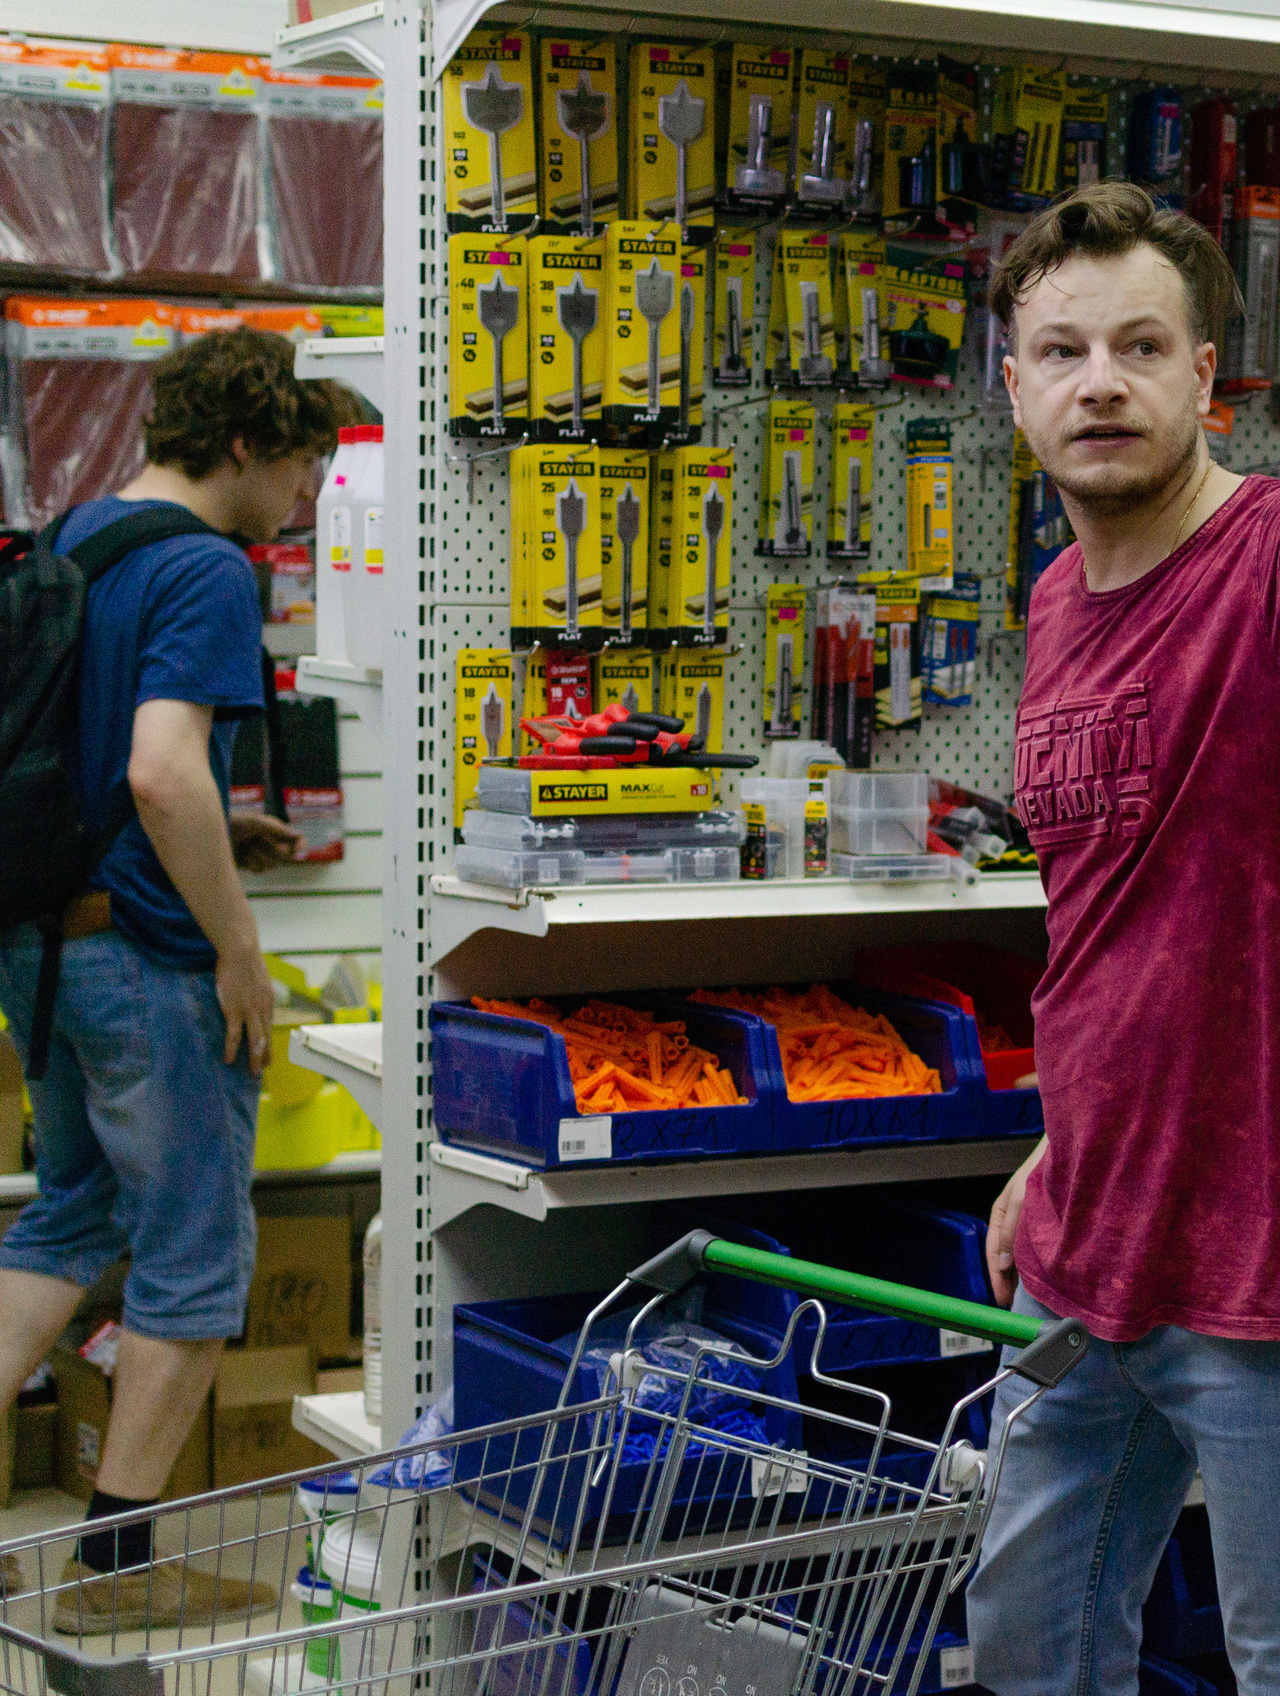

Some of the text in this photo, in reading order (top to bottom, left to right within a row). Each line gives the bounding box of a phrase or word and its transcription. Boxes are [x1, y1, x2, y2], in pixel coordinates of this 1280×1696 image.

[656, 64, 698, 75] STAYER
[740, 63, 785, 77] STAYER
[482, 224, 509, 233] FLAT
[622, 241, 673, 253] STAYER
[467, 252, 518, 264] STAR
[546, 255, 598, 268] STAYER
[634, 413, 658, 422] FLAT
[481, 426, 507, 436] FLAT
[559, 428, 585, 437] FLAT
[543, 464, 591, 475] STAYER
[603, 468, 643, 477] STAYER
[541, 482, 555, 493] 25
[558, 633, 582, 641] FLAT
[609, 636, 632, 644] FLAT
[694, 635, 715, 643] FLAT
[465, 667, 507, 677] STAYER
[604, 667, 646, 678] STAYER
[683, 666, 719, 677] STAYER
[464, 687, 476, 698] 18
[606, 687, 618, 698] 14
[553, 786, 606, 798] STAYER
[1015, 780, 1114, 828] NEVADA
[687, 1664, 698, 1676] NO
[716, 1674, 727, 1686] NO
